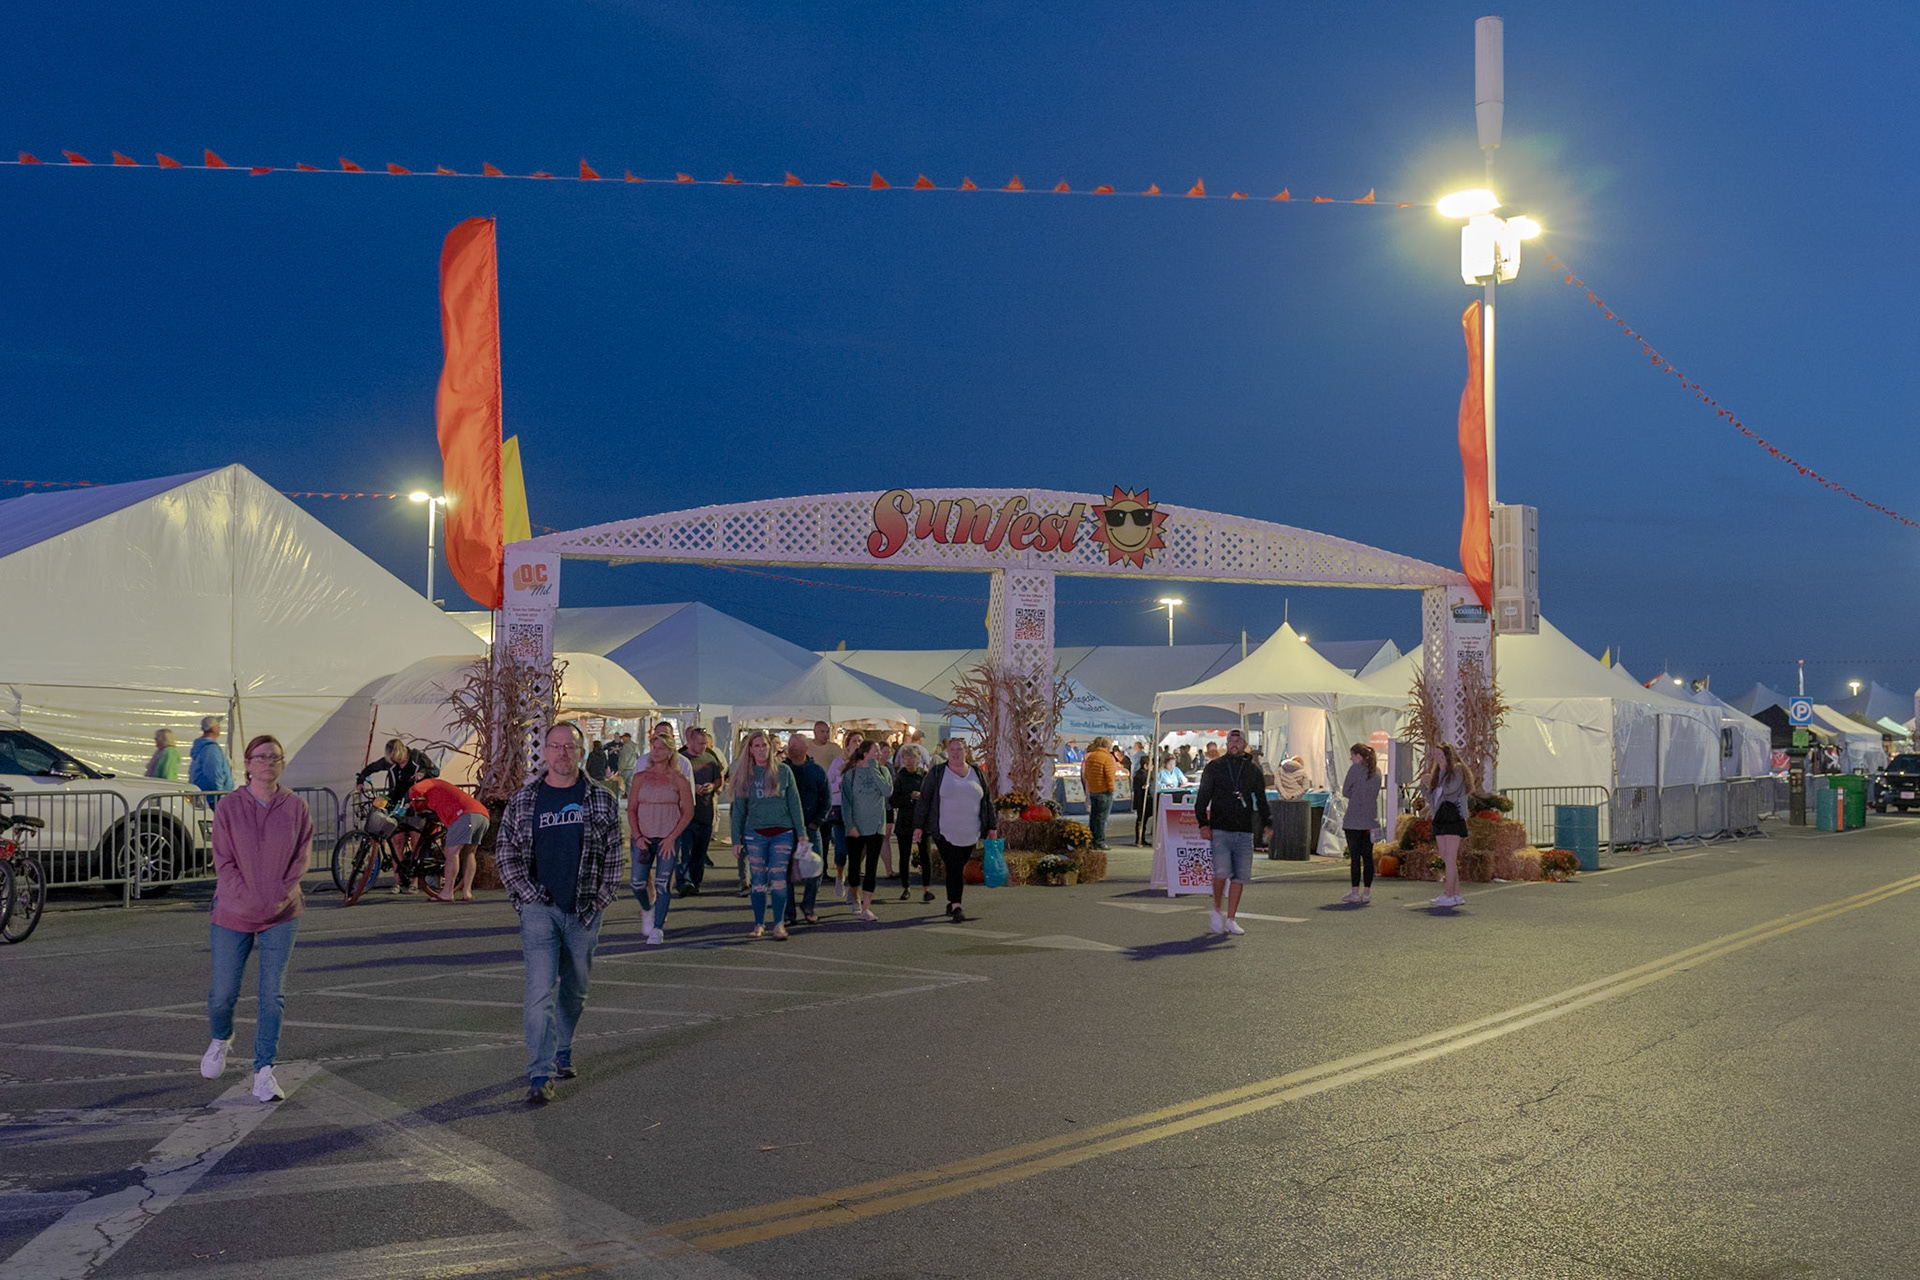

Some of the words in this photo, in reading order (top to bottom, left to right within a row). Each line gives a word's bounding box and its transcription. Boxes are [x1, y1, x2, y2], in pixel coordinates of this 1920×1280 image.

[867, 489, 1087, 558] Sunfest
[517, 563, 548, 585] OC
[531, 583, 553, 597] Md
[1454, 607, 1483, 615] coastal
[1796, 704, 1807, 718] P
